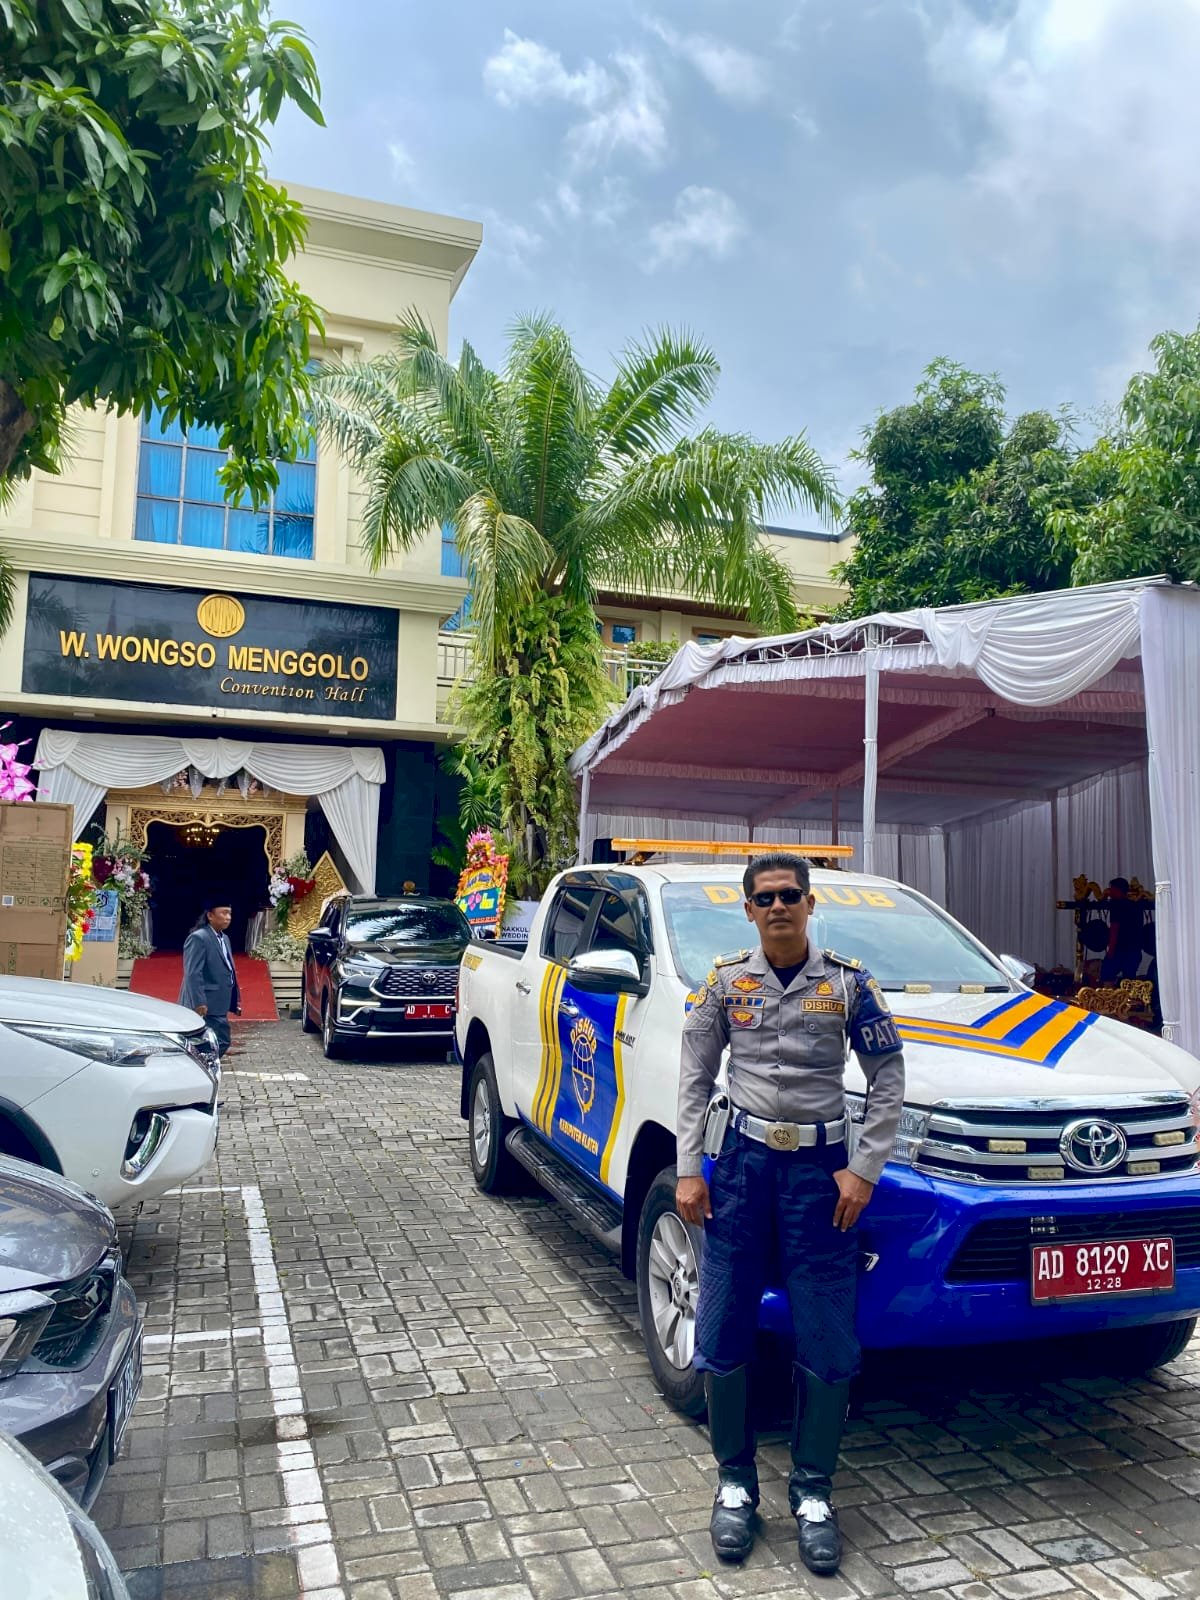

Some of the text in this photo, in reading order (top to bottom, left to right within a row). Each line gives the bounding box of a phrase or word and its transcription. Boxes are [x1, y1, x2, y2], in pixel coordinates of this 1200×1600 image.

[60, 630, 369, 682] W. WONGSO MENGGOLO
[219, 676, 368, 703] Convention Hall
[703, 885, 897, 908] DUB
[406, 1005, 450, 1015] AD 1 C
[805, 1001, 843, 1011] DISHUB
[570, 1017, 597, 1054] DISHUB
[1038, 1242, 1169, 1280] AD 8129 XC
